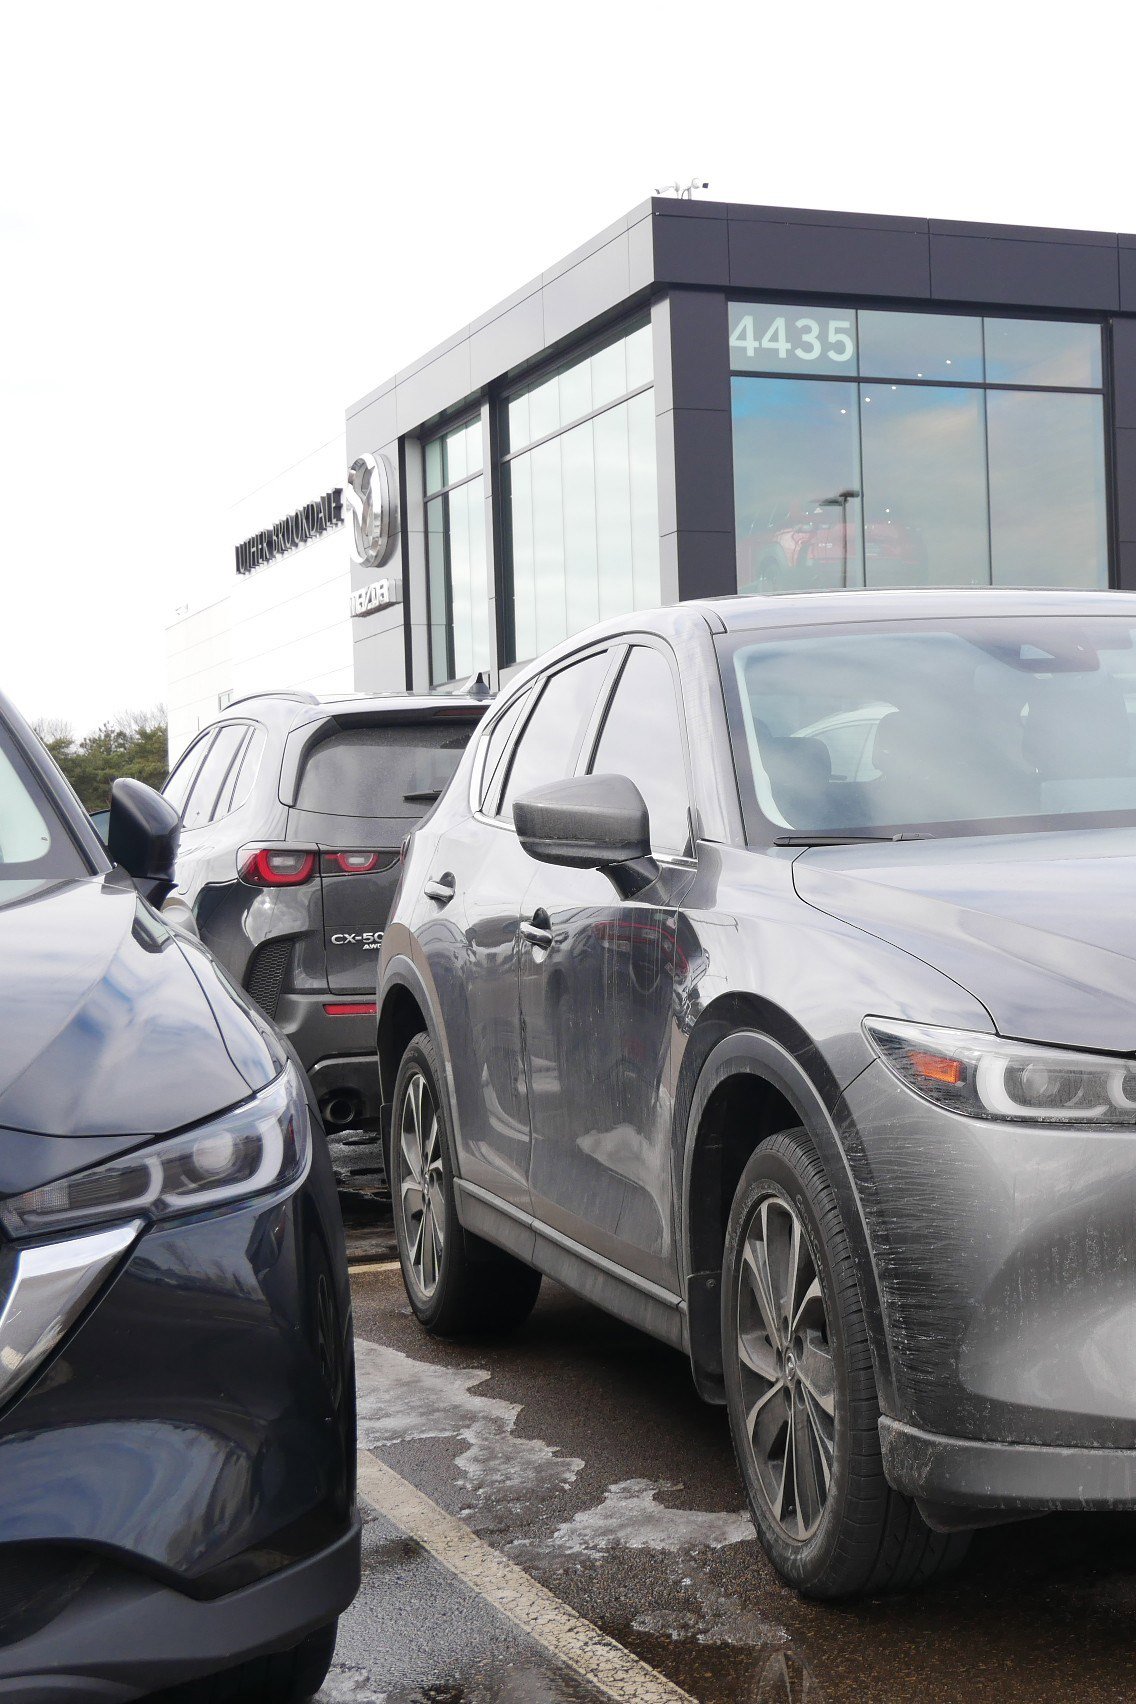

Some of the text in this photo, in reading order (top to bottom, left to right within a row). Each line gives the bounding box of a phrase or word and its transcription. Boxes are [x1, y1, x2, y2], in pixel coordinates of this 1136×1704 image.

[729, 315, 854, 362] 4435
[272, 487, 344, 559] BROOKDALE
[331, 931, 384, 945] CX-50
